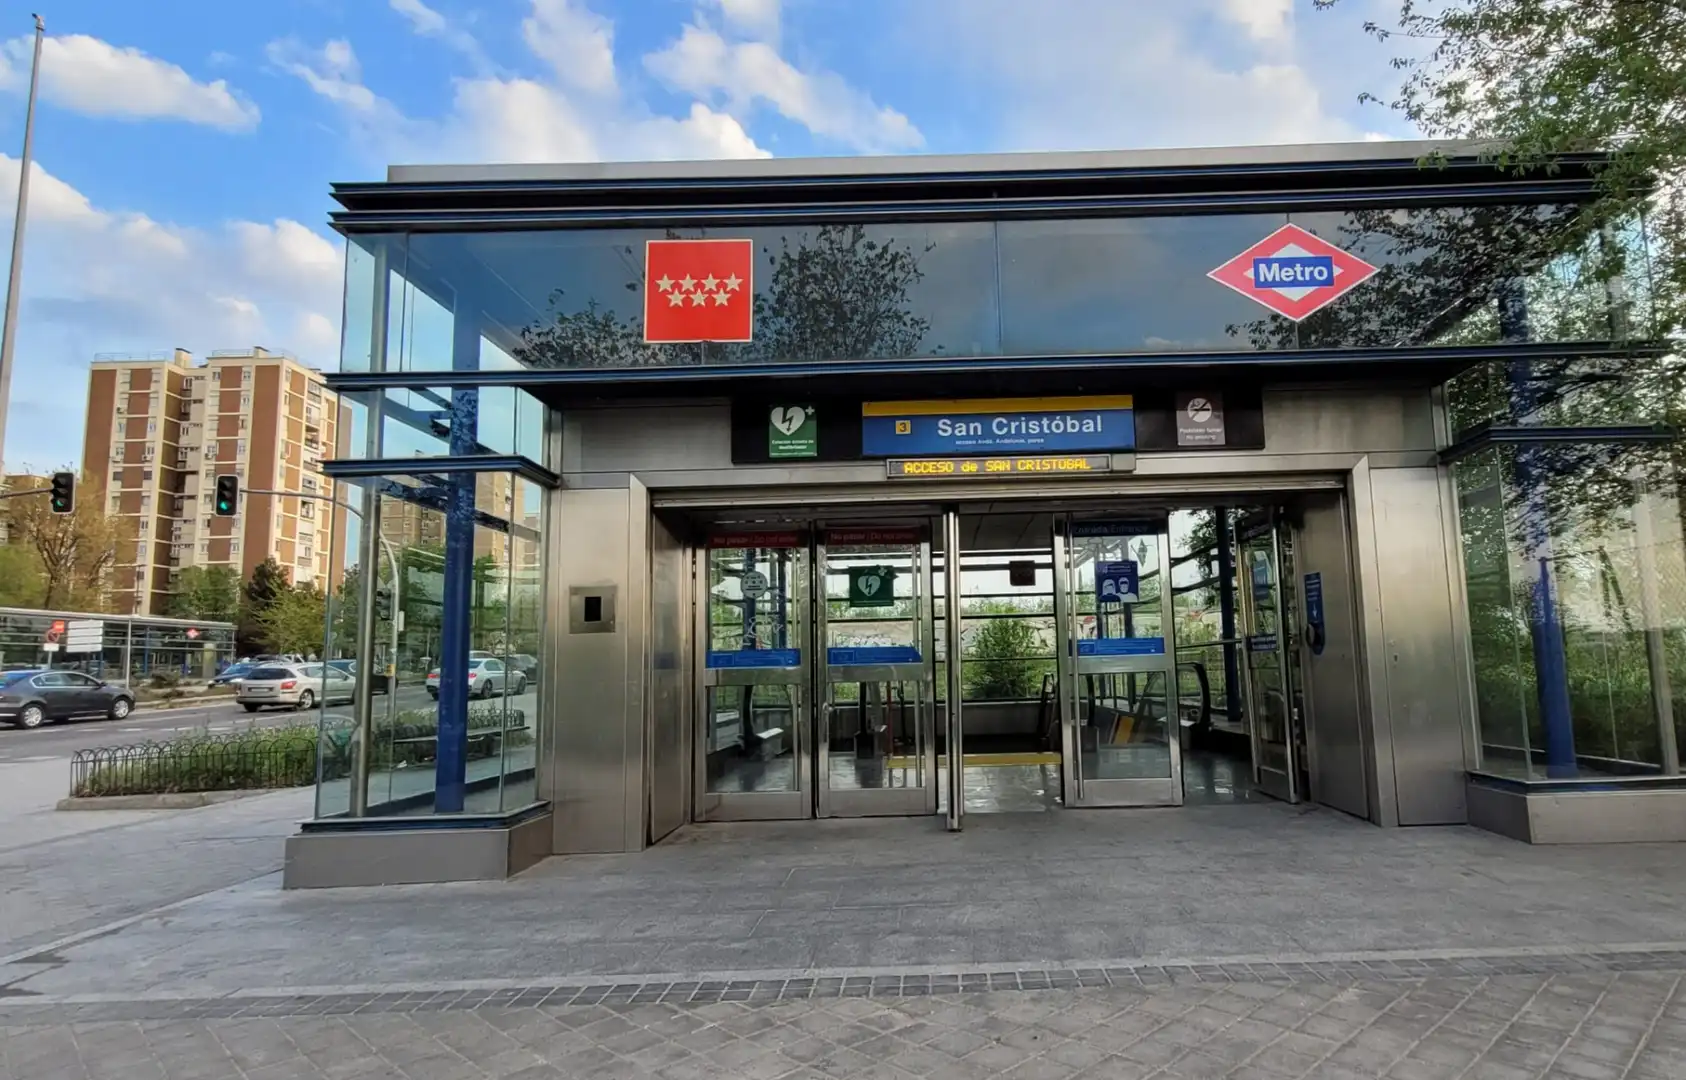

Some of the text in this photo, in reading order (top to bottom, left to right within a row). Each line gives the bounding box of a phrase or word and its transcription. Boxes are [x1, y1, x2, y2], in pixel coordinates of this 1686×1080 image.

[1258, 263, 1329, 282] Metro
[899, 422, 908, 433] 3
[937, 415, 1102, 437] San Cristóbal
[904, 458, 1091, 474] ACCESO de SAN CRISTOBAL
